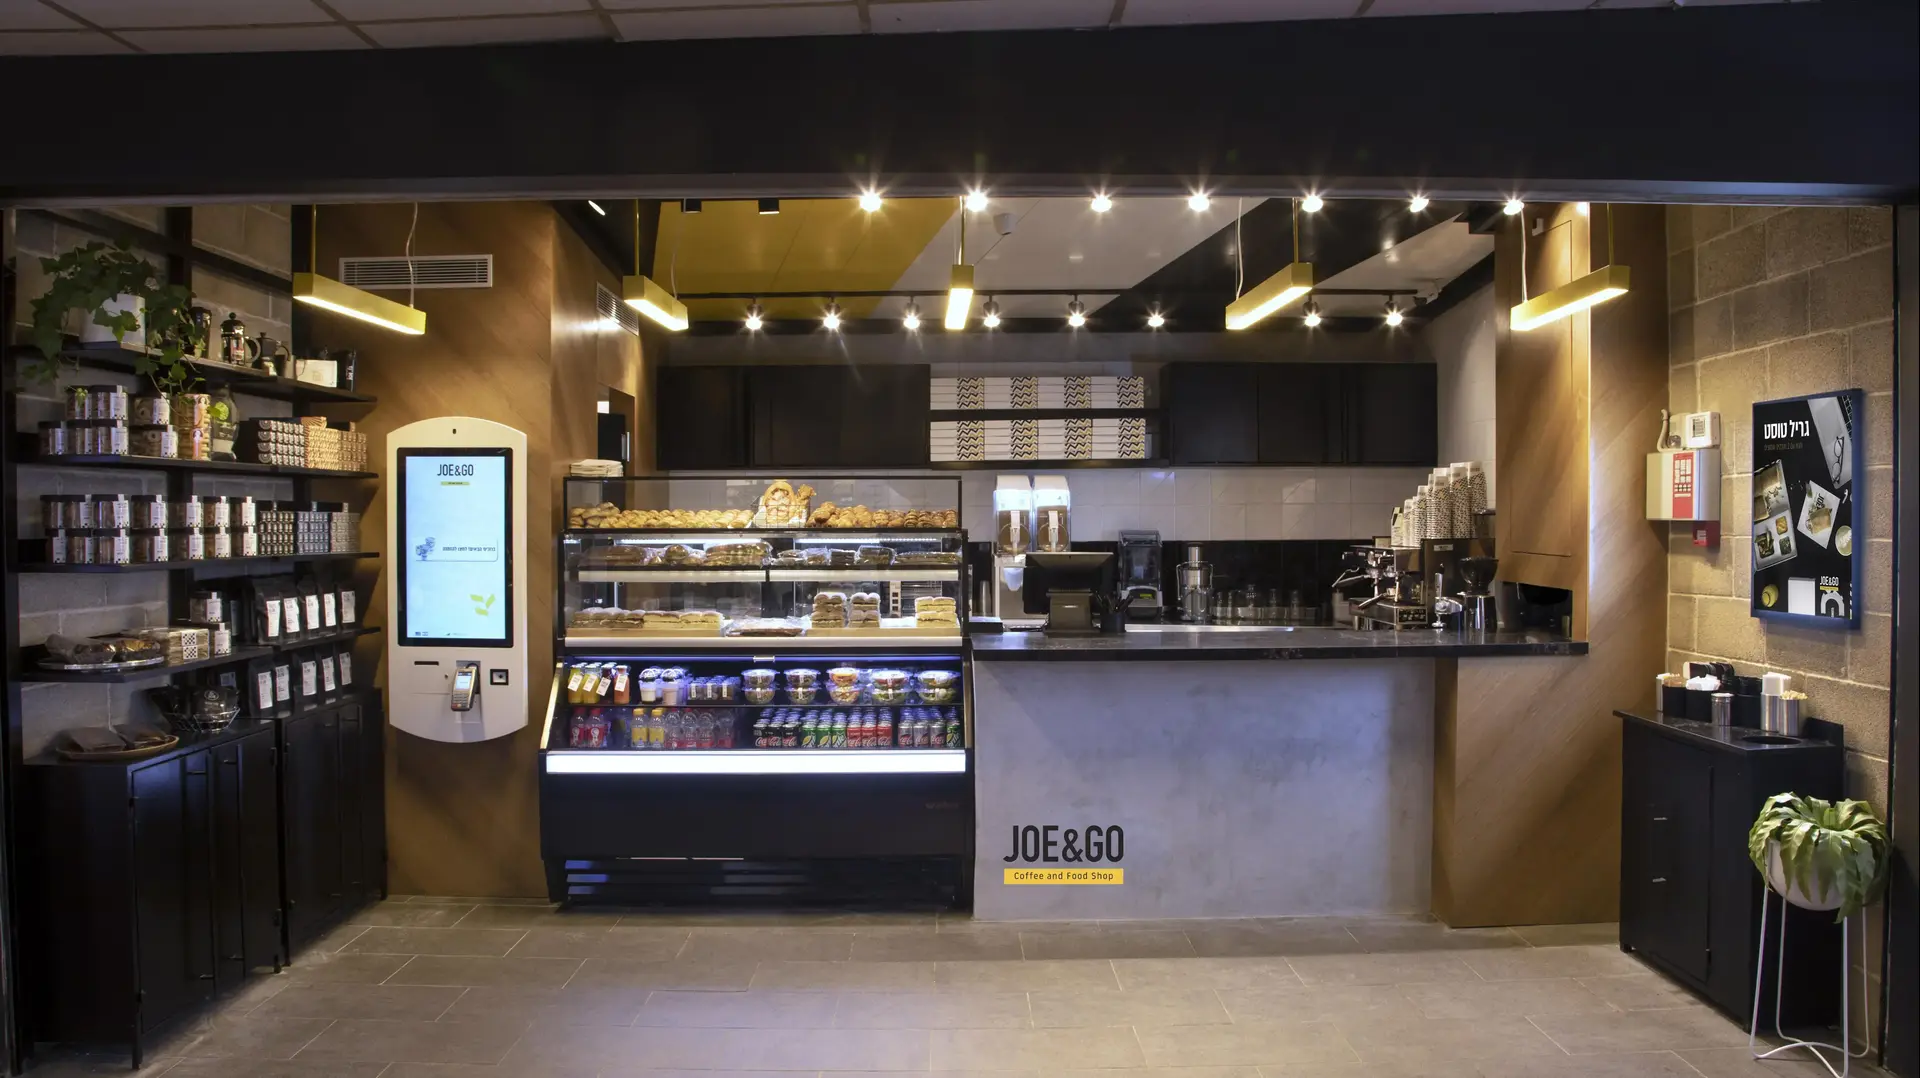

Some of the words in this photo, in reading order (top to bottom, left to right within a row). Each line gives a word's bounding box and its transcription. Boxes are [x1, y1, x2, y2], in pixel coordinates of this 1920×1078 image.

[1763, 422, 1788, 439] טוסט
[1789, 420, 1809, 437] גריל
[437, 464, 474, 476] JOE&GO
[1820, 575, 1839, 586] JOE&GO
[1003, 825, 1124, 862] JOE&GO
[1014, 872, 1044, 880] Coffee
[1046, 872, 1063, 880] and
[1066, 872, 1088, 880] Food
[1091, 872, 1114, 881] Shop
